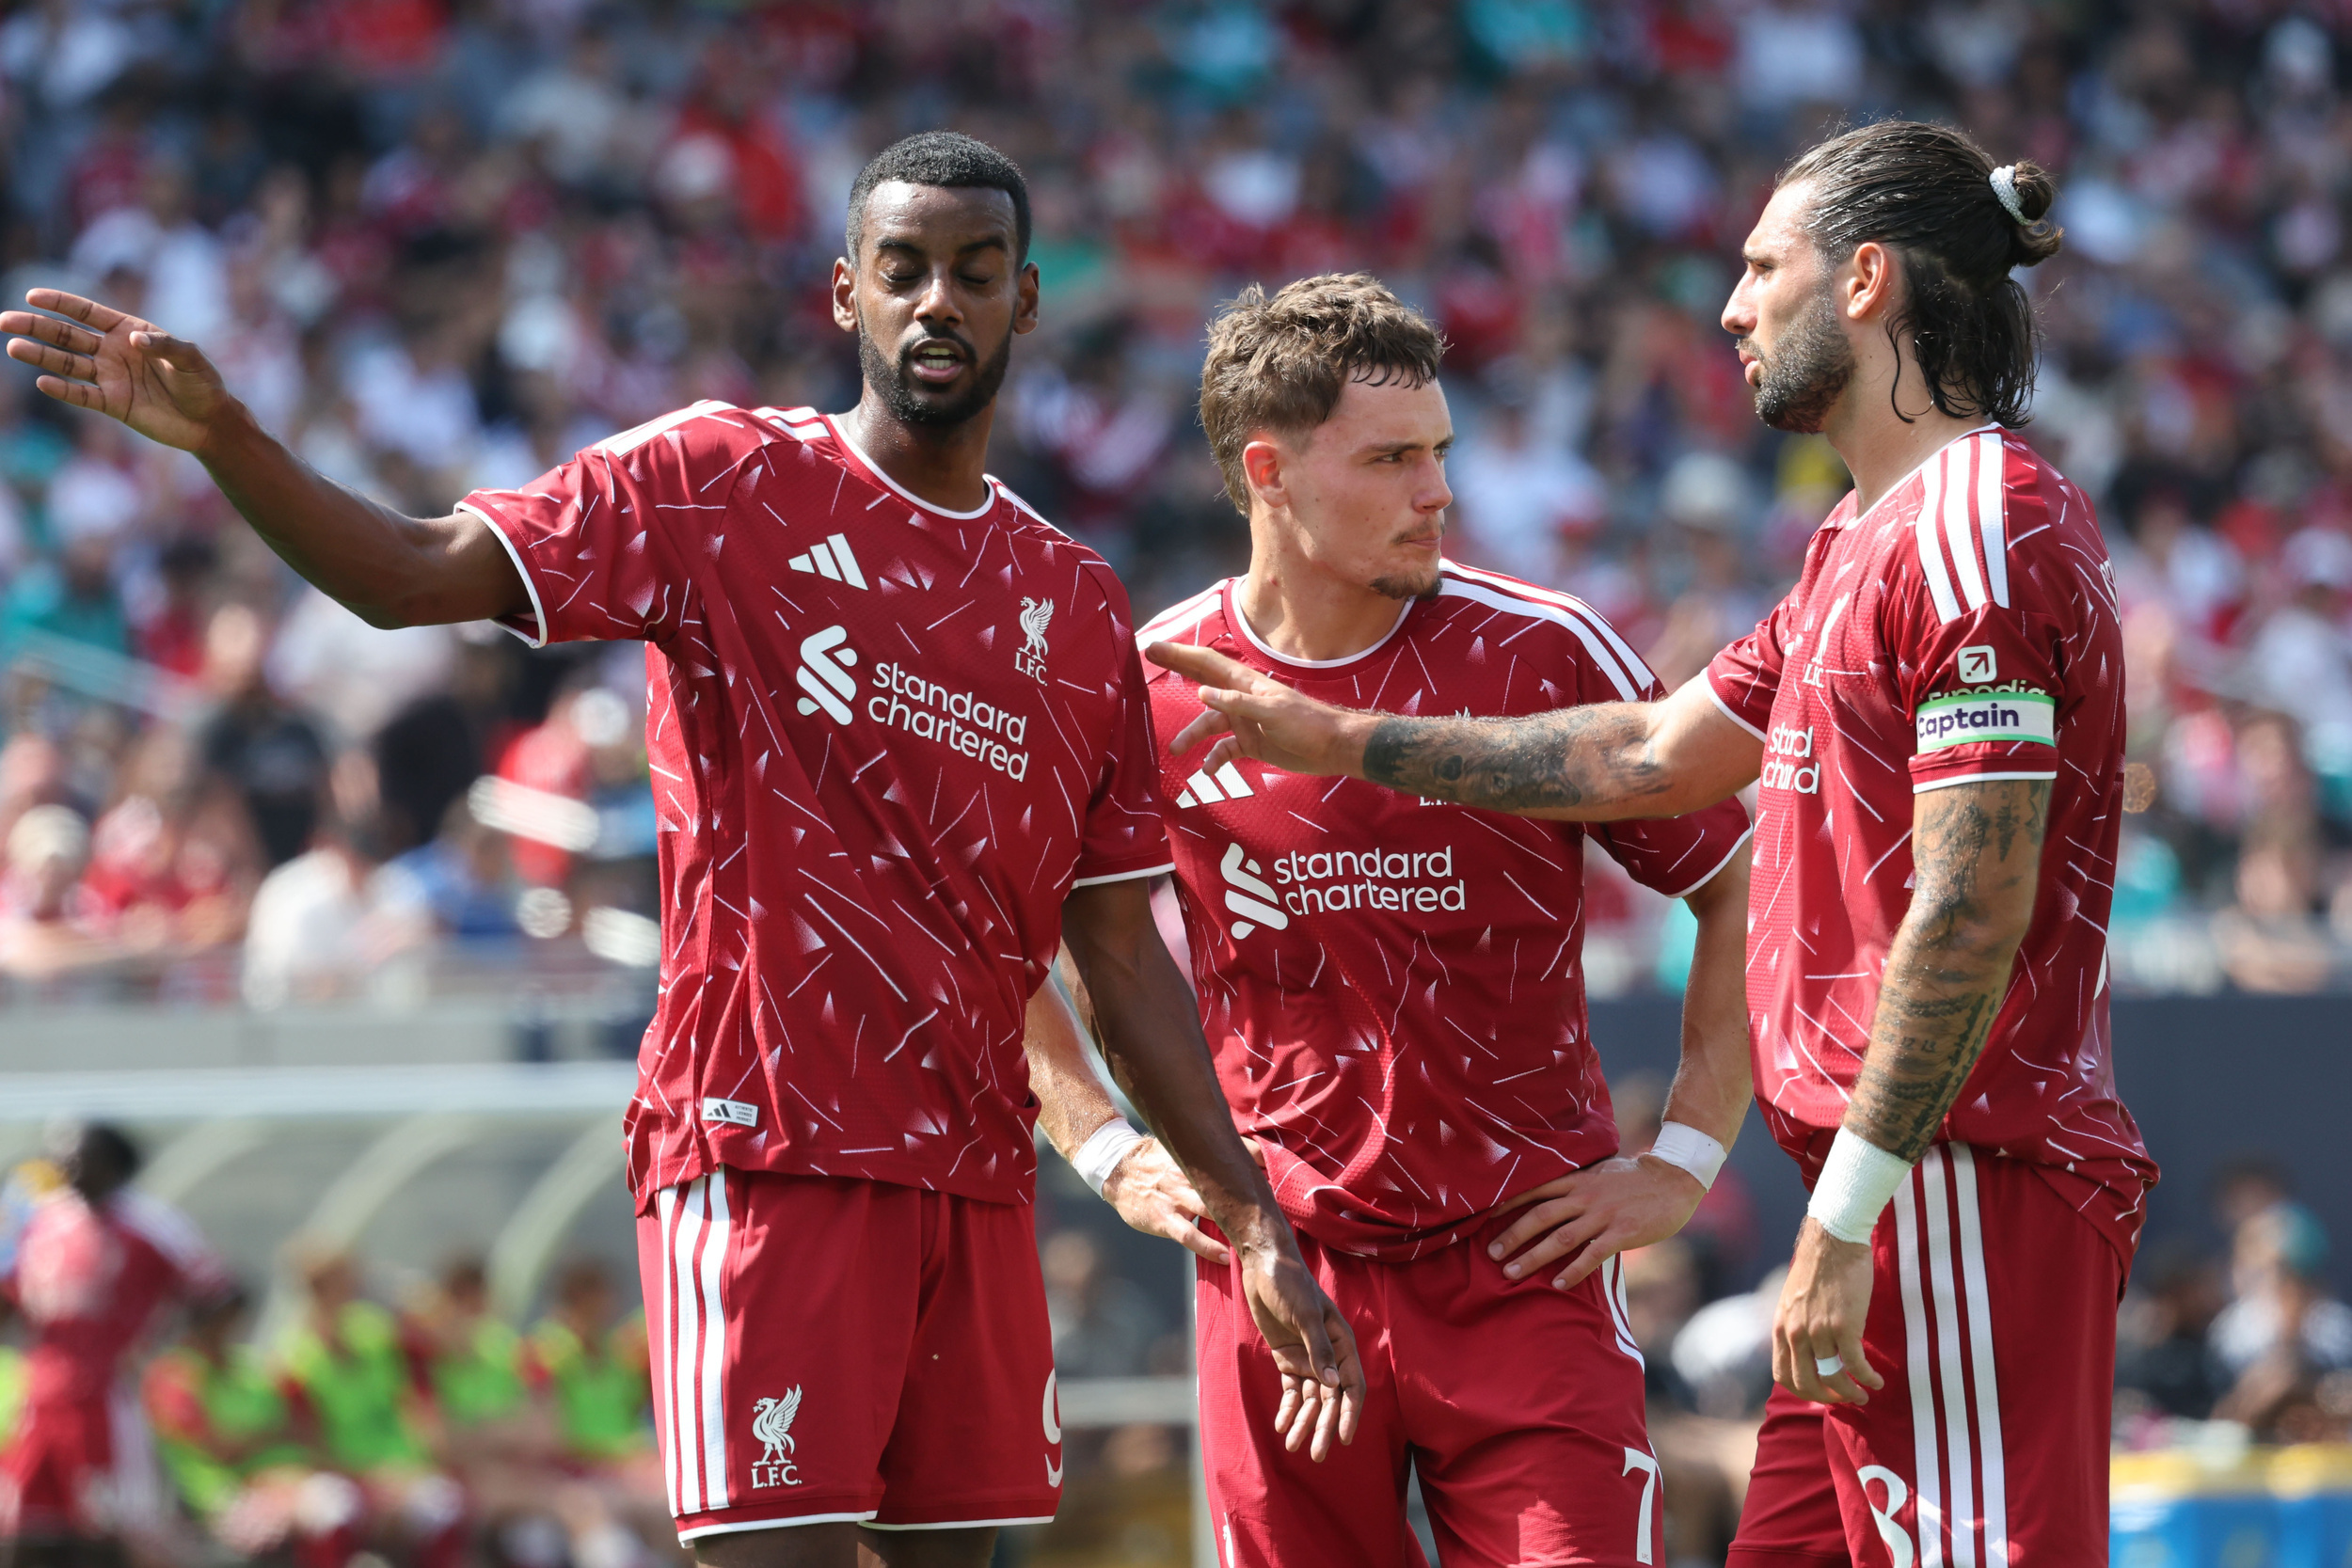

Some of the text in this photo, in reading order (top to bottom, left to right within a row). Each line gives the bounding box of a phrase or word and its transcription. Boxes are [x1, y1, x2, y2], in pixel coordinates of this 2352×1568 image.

[1014, 651, 1048, 687] L.F.C.
[872, 661, 1027, 745] standard
[1917, 703, 2020, 738] Captain
[867, 694, 1029, 783] chartered
[1273, 845, 1453, 884] standard
[1285, 879, 1466, 916] chartered
[751, 1465, 803, 1490] L.F.C.
[1622, 1447, 1657, 1566] 7
